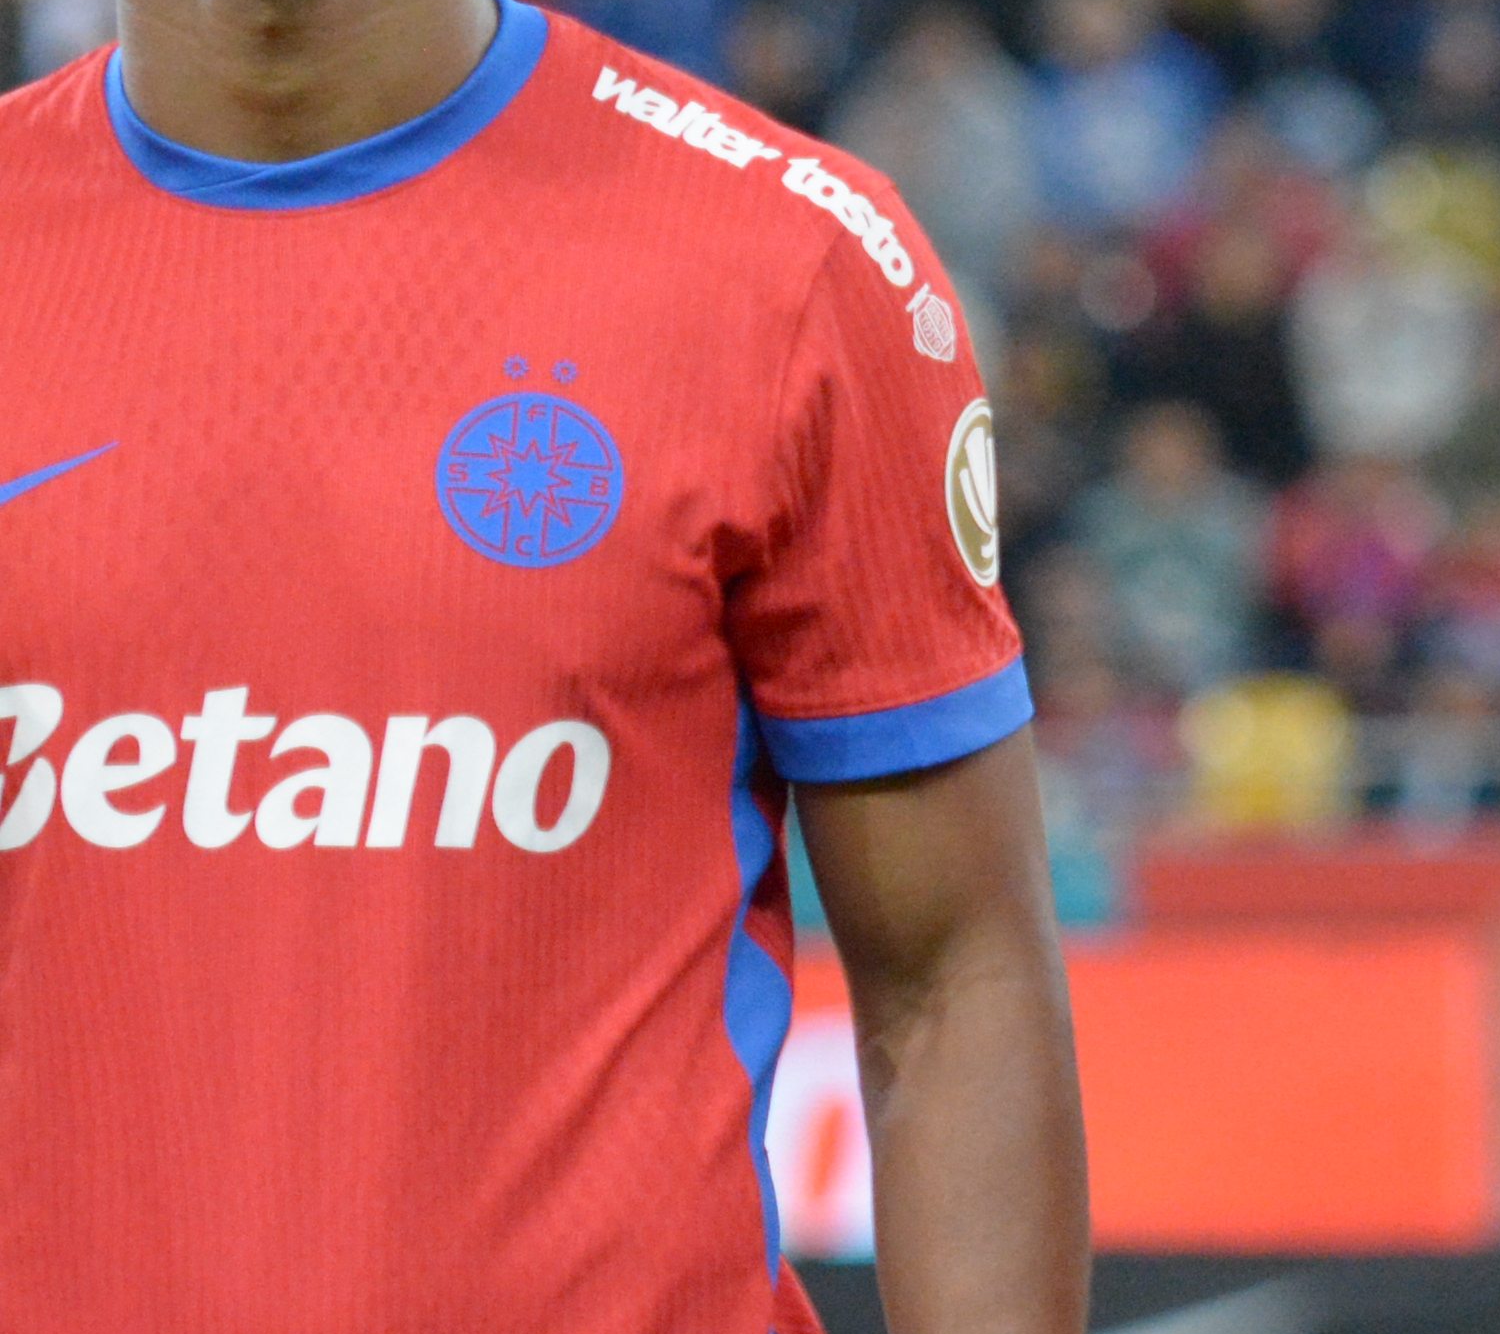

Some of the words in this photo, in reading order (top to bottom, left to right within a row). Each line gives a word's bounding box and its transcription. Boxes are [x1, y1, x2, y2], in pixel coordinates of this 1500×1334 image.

[592, 65, 783, 169] walter
[781, 157, 915, 287] tosto
[526, 404, 547, 423] F
[447, 463, 470, 483] S
[588, 475, 609, 496] B
[514, 534, 535, 557] C
